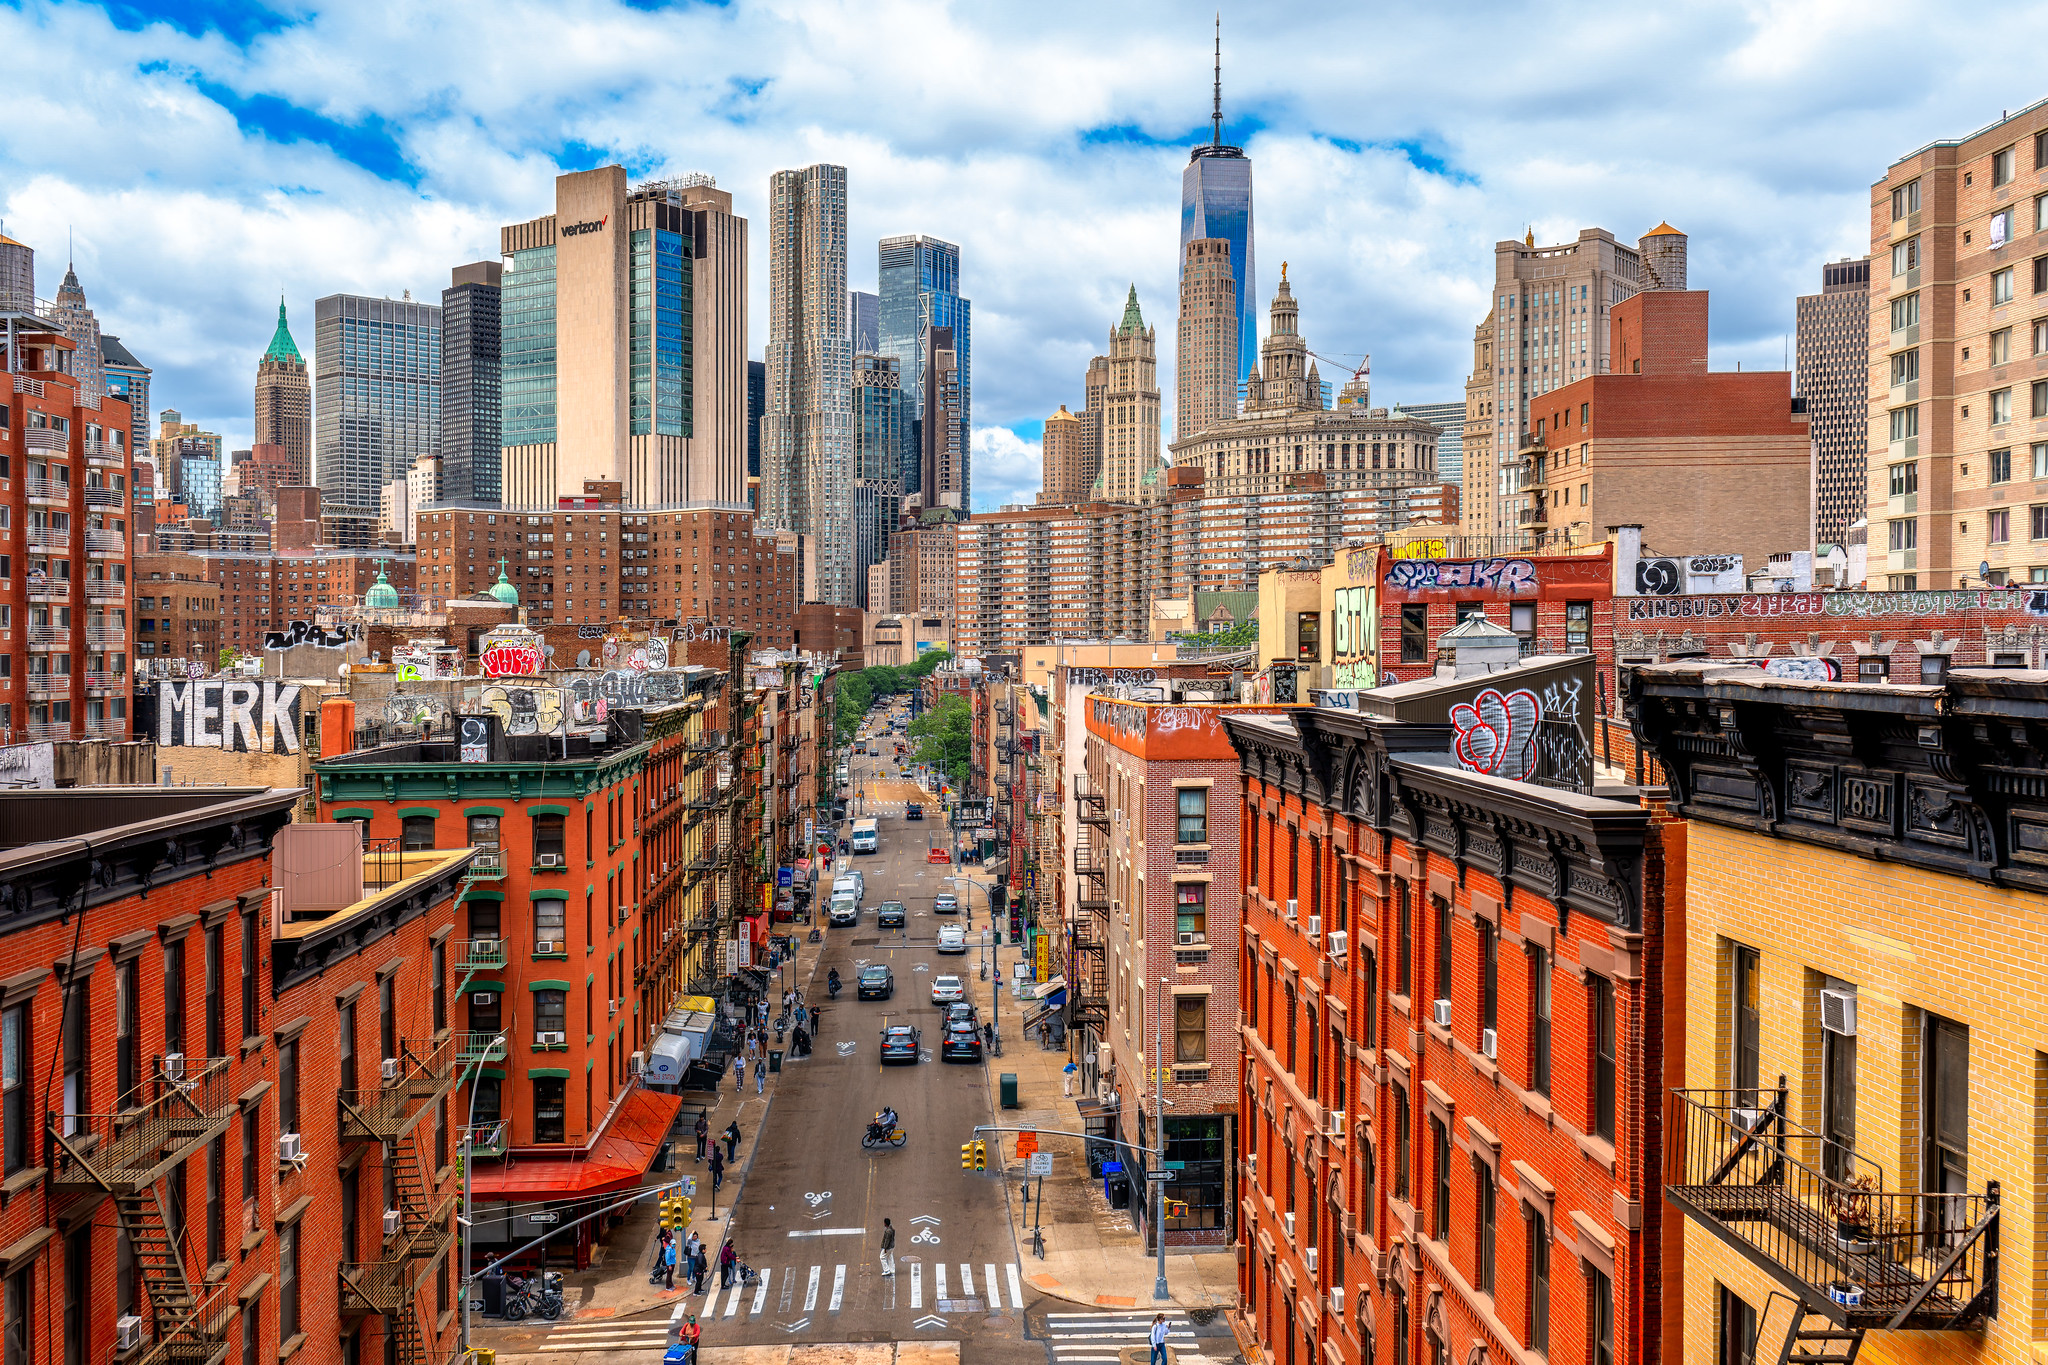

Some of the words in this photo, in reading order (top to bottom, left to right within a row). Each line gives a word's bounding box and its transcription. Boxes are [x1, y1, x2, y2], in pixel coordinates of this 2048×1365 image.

[561, 220, 602, 237] verizon
[1335, 585, 1376, 657] BTM
[159, 681, 300, 755] MERK
[1844, 780, 1885, 818] 1891
